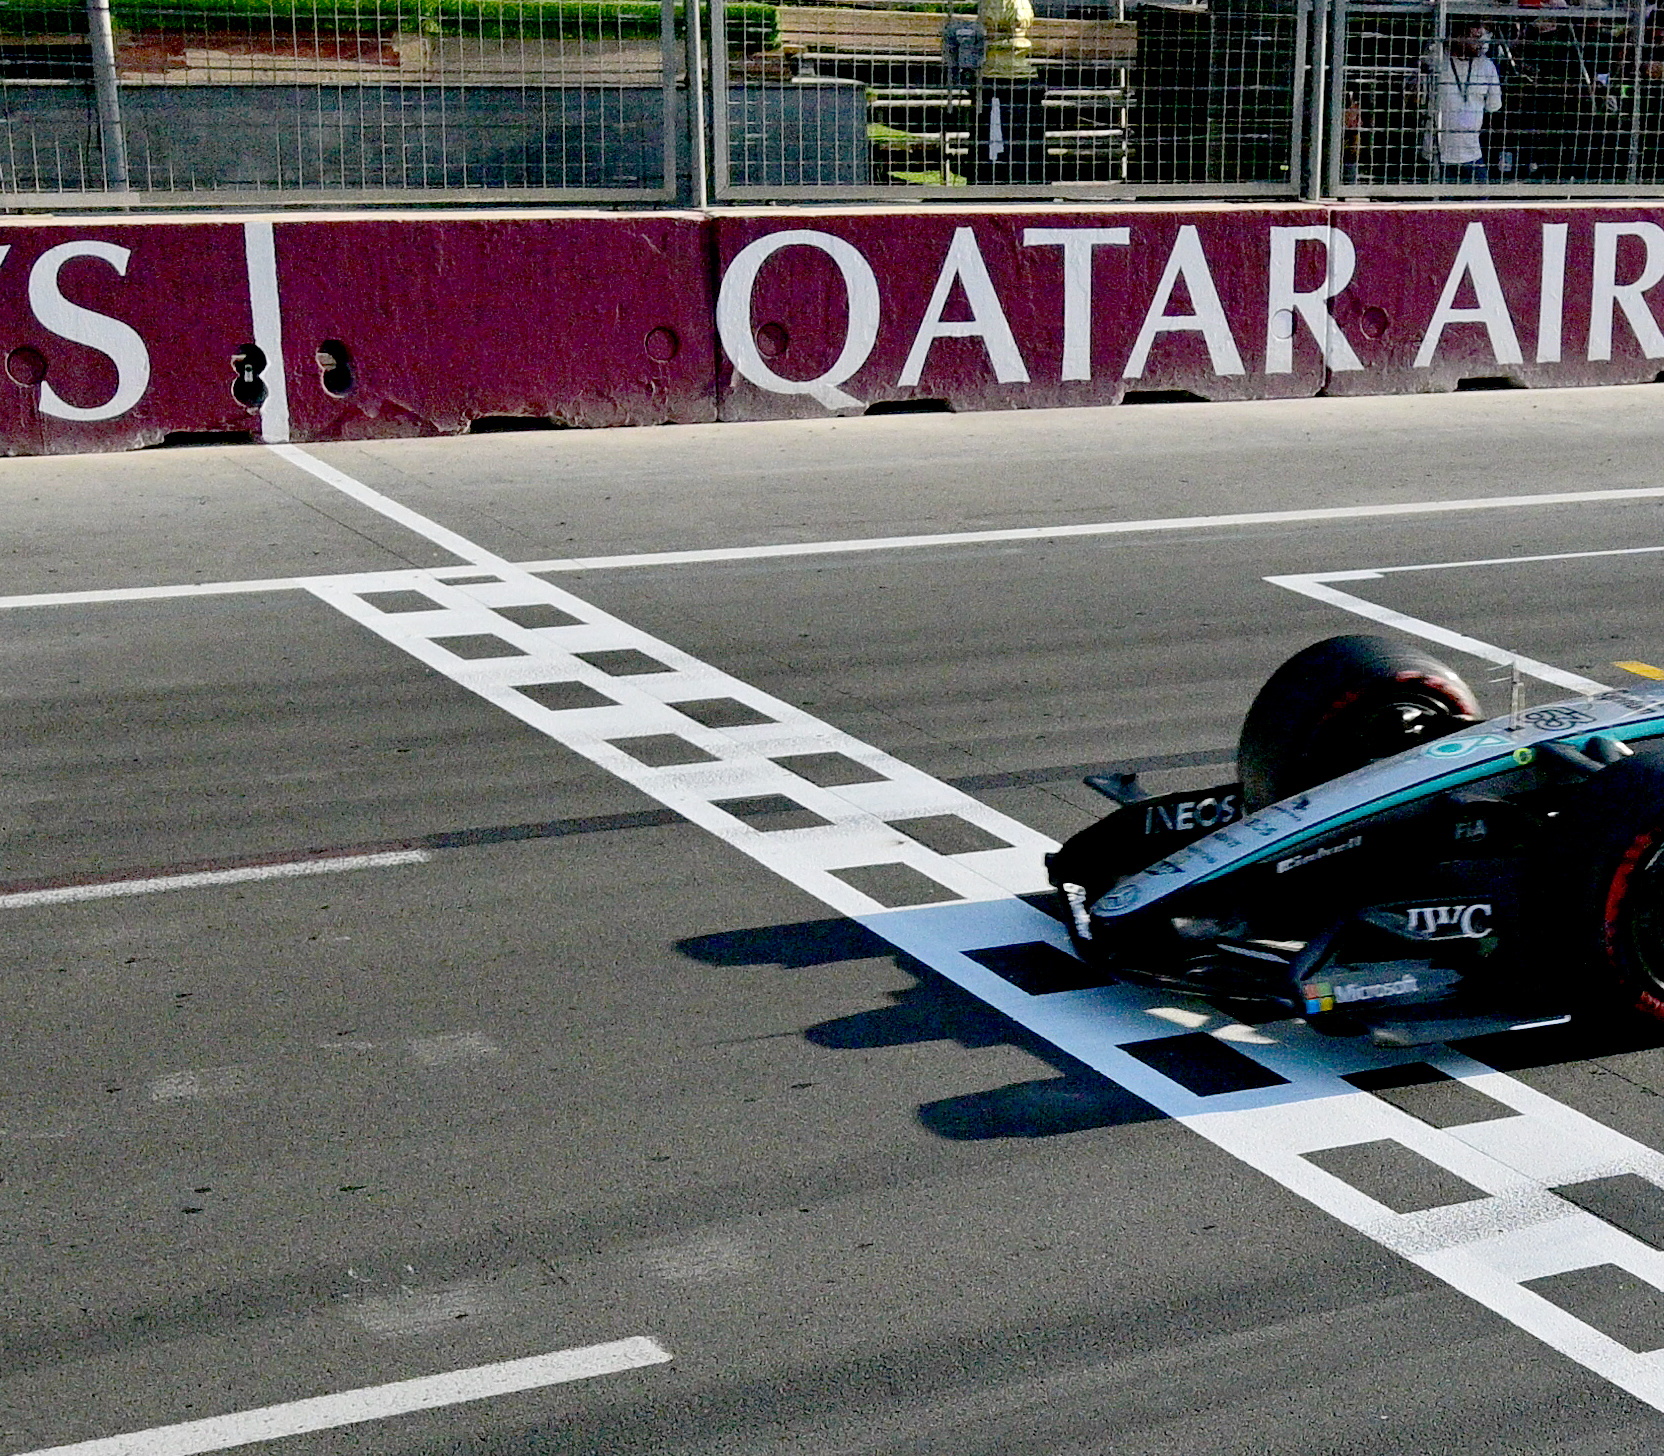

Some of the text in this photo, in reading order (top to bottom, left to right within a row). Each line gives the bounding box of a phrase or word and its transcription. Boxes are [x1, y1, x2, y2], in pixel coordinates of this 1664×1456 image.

[716, 224, 1365, 408] QATAR
[1145, 794, 1236, 835] INEOS
[1406, 903, 1493, 939] IWC
